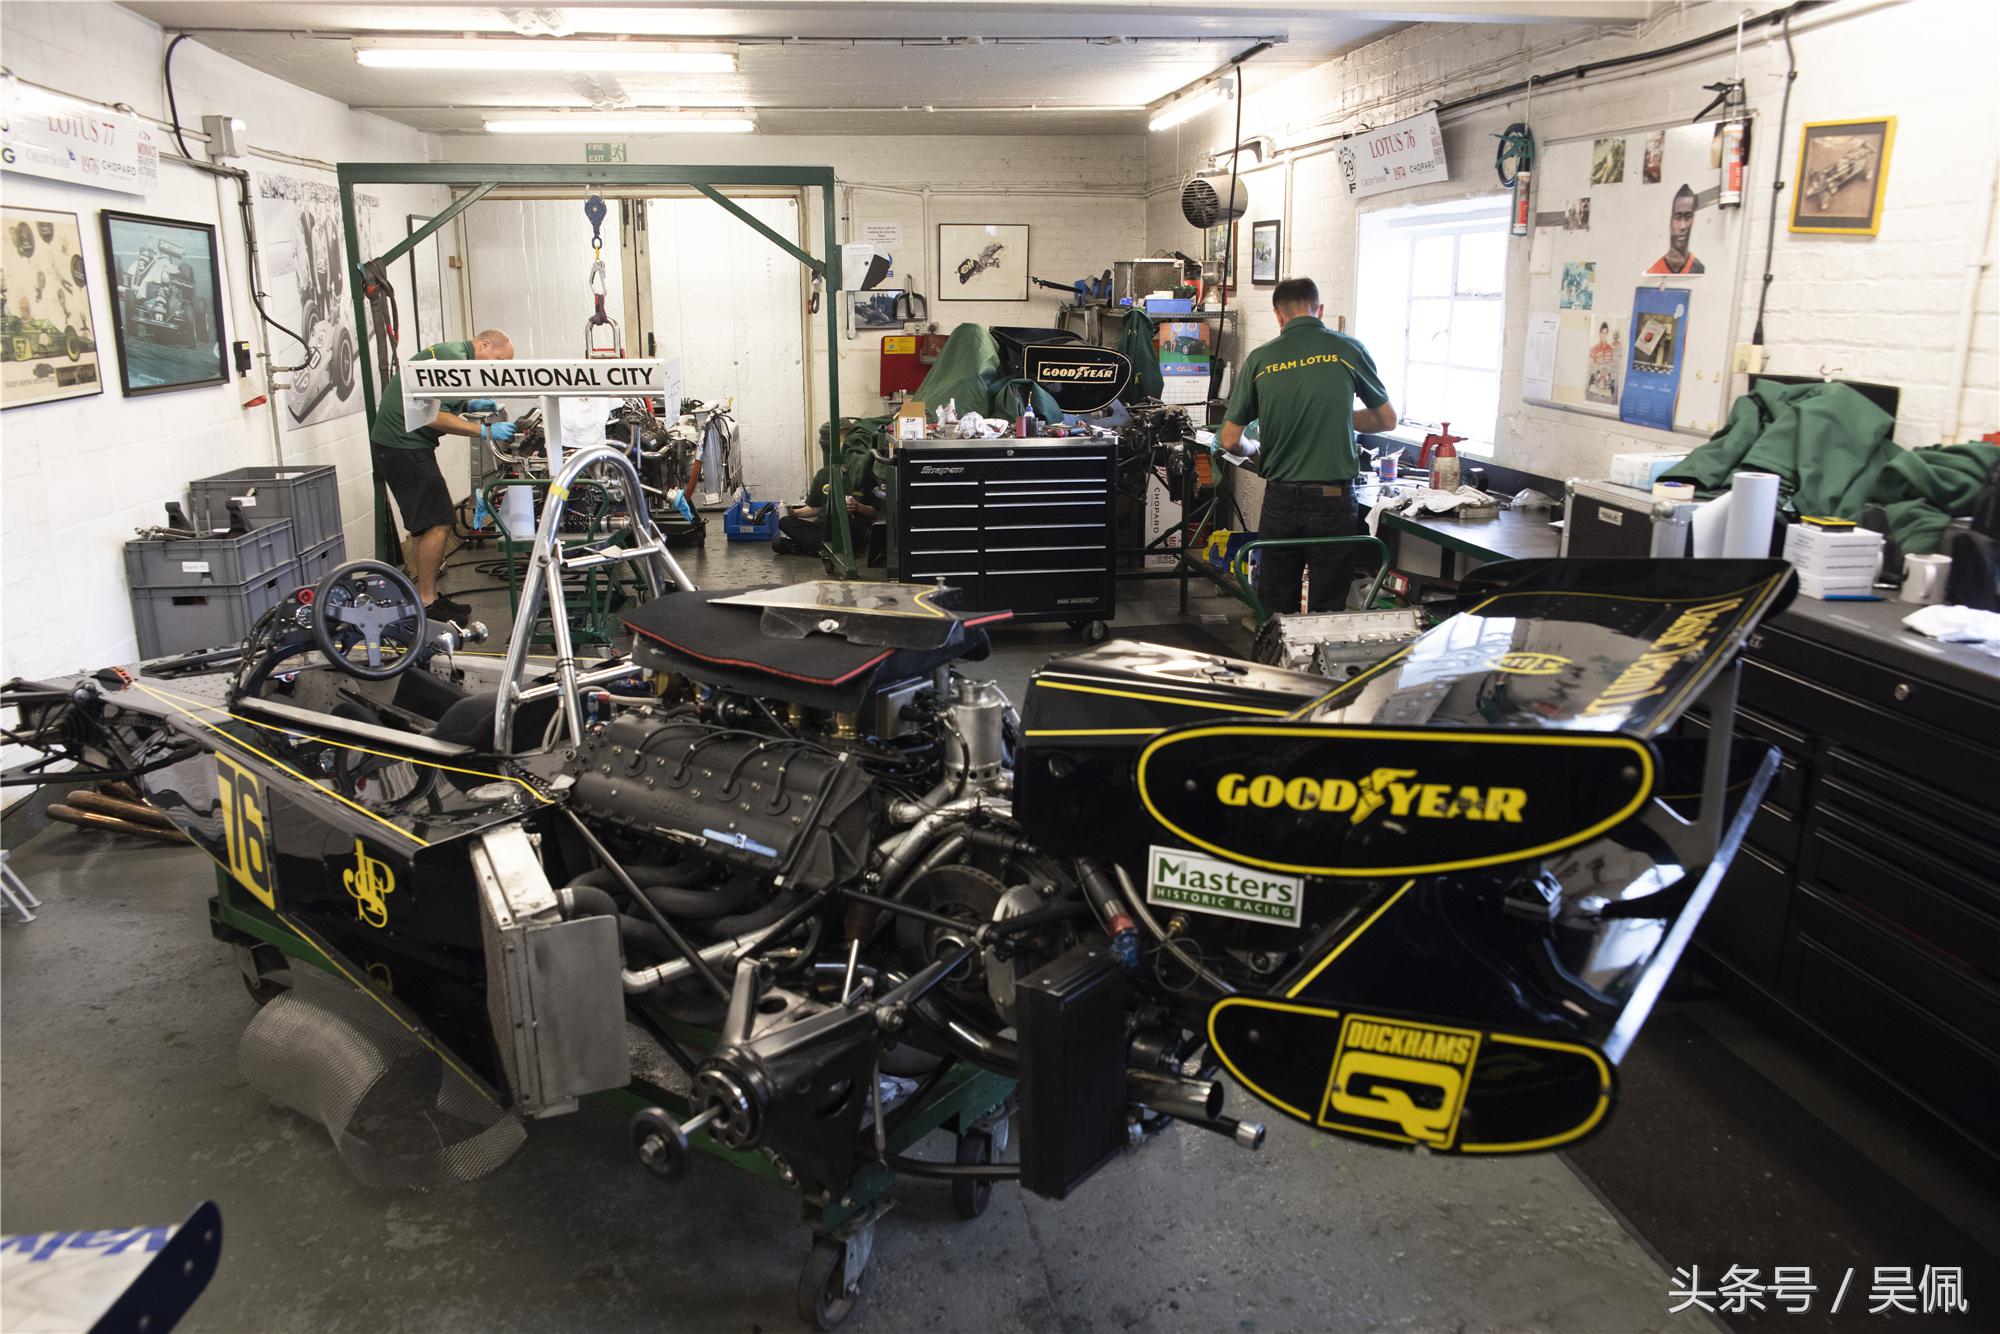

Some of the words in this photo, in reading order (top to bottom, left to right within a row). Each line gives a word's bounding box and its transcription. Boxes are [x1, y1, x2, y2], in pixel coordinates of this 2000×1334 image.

[48, 115, 99, 142] LOTUS
[102, 122, 116, 146] 77
[588, 143, 605, 151] FIRE
[1369, 132, 1404, 159] LOTUS
[1403, 128, 1416, 149] 76
[80, 155, 100, 176] 1976
[102, 159, 137, 177] CHOPARD
[588, 154, 604, 162] EXIT
[1409, 160, 1435, 174] CHOPARD
[1343, 160, 1354, 177] 29
[1393, 166, 1407, 180] 1974
[1349, 182, 1357, 194] F
[1265, 360, 1297, 374] TEAM
[1300, 354, 1338, 367] LOTUS
[415, 368, 472, 387] FIRST
[479, 367, 601, 387] NATIONAL
[606, 367, 653, 386] CITY
[921, 465, 965, 475] Snap-on
[216, 757, 271, 893] 76
[1158, 857, 1292, 902] Masters
[1156, 887, 1226, 907] HISTORIC
[1234, 900, 1292, 918] RACING
[1346, 1021, 1473, 1065] DUCKHAMS
